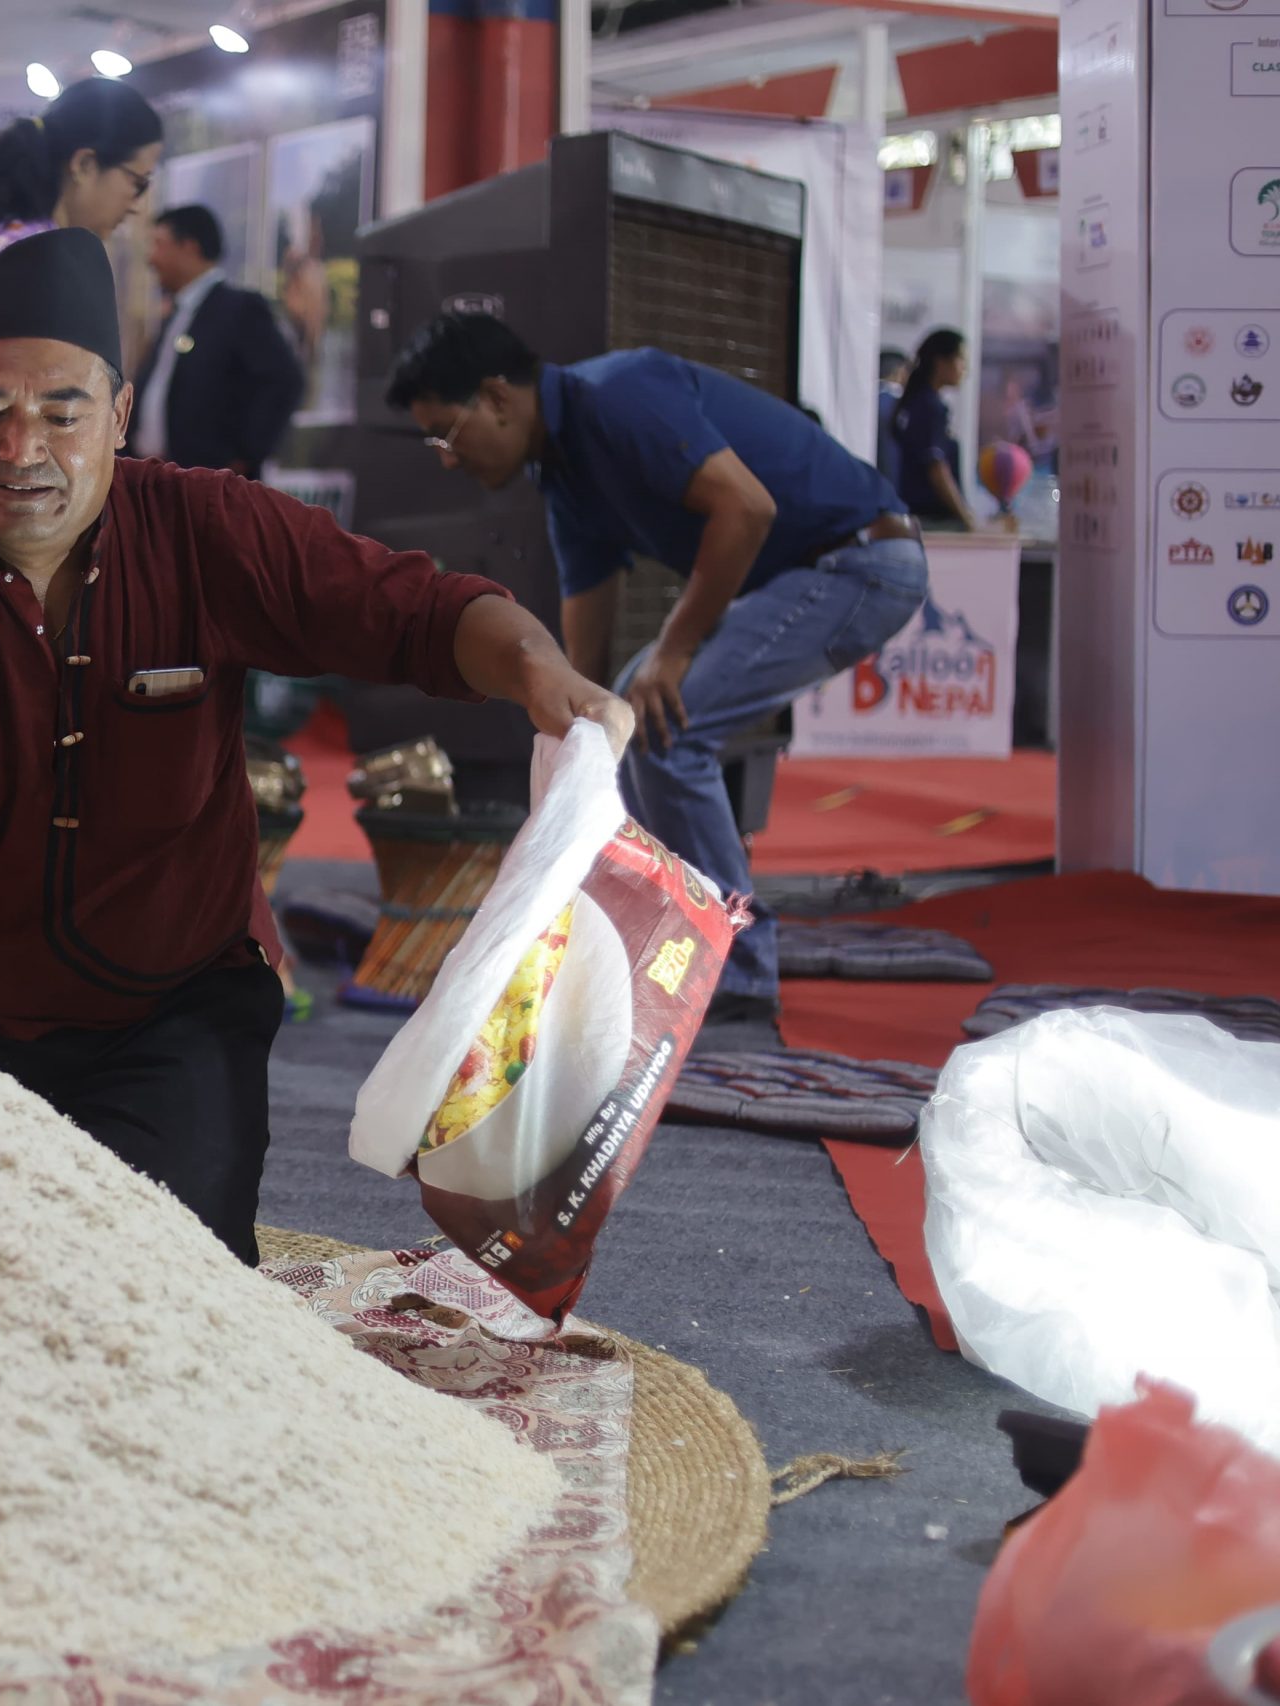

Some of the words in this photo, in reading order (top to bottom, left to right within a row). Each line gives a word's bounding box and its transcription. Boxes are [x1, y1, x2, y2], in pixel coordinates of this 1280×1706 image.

[557, 1211, 574, 1227] S.
[568, 1191, 586, 1209] K.
[579, 1110, 637, 1190] KHADHYA
[630, 1040, 672, 1110] UDHYOG
[584, 1121, 605, 1145] Mfg.
